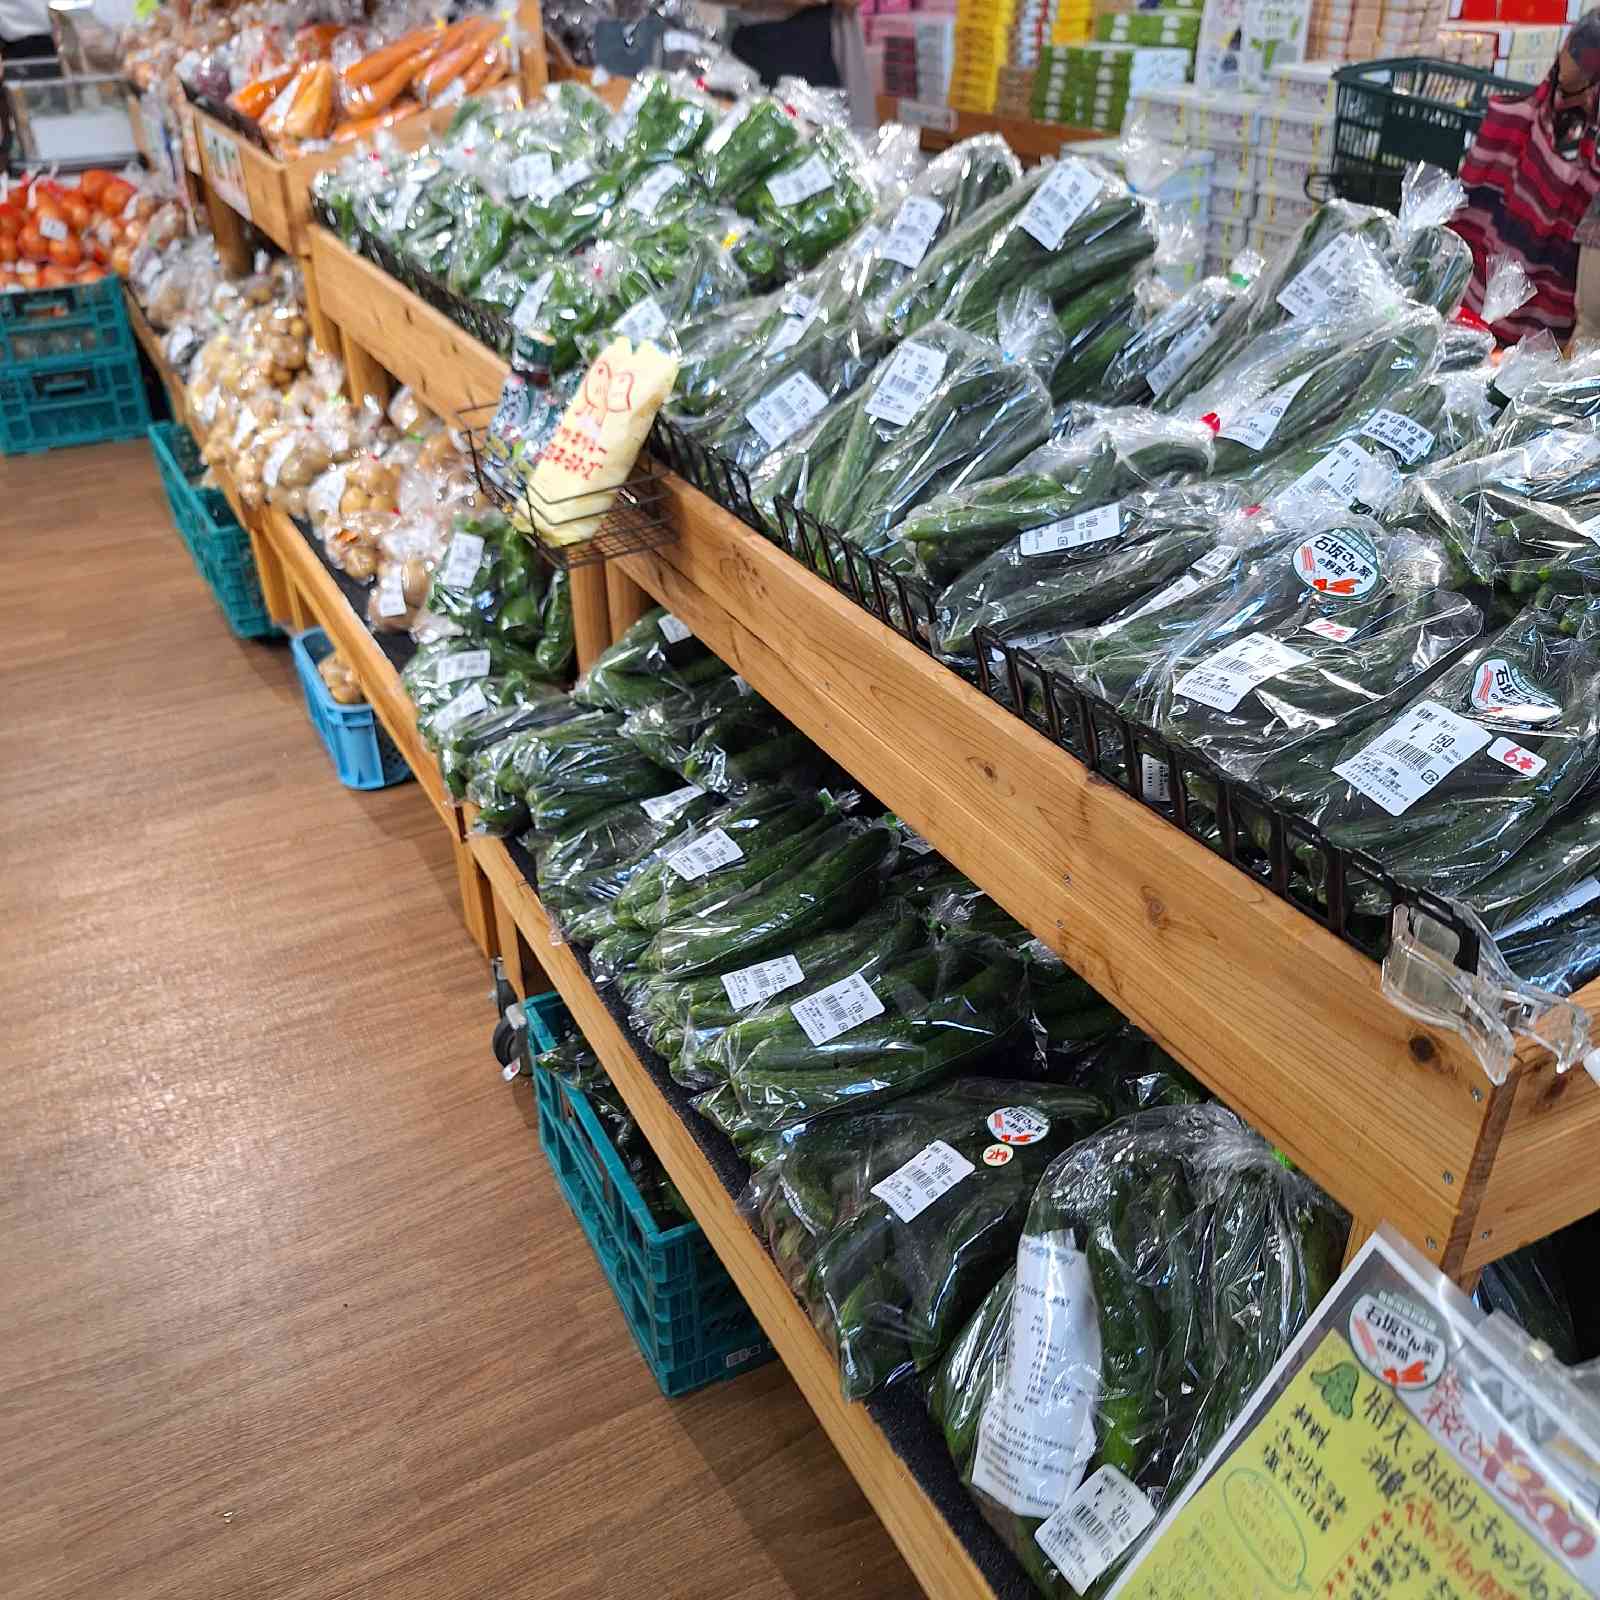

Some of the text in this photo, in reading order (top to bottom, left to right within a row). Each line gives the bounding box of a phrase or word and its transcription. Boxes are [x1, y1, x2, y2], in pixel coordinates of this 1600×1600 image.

[1314, 536, 1373, 580] 石坂さん家
[1425, 741, 1443, 754] 139
[1432, 732, 1456, 748] 150
[1503, 746, 1536, 771] 6本
[986, 1149, 1009, 1162] 2kg
